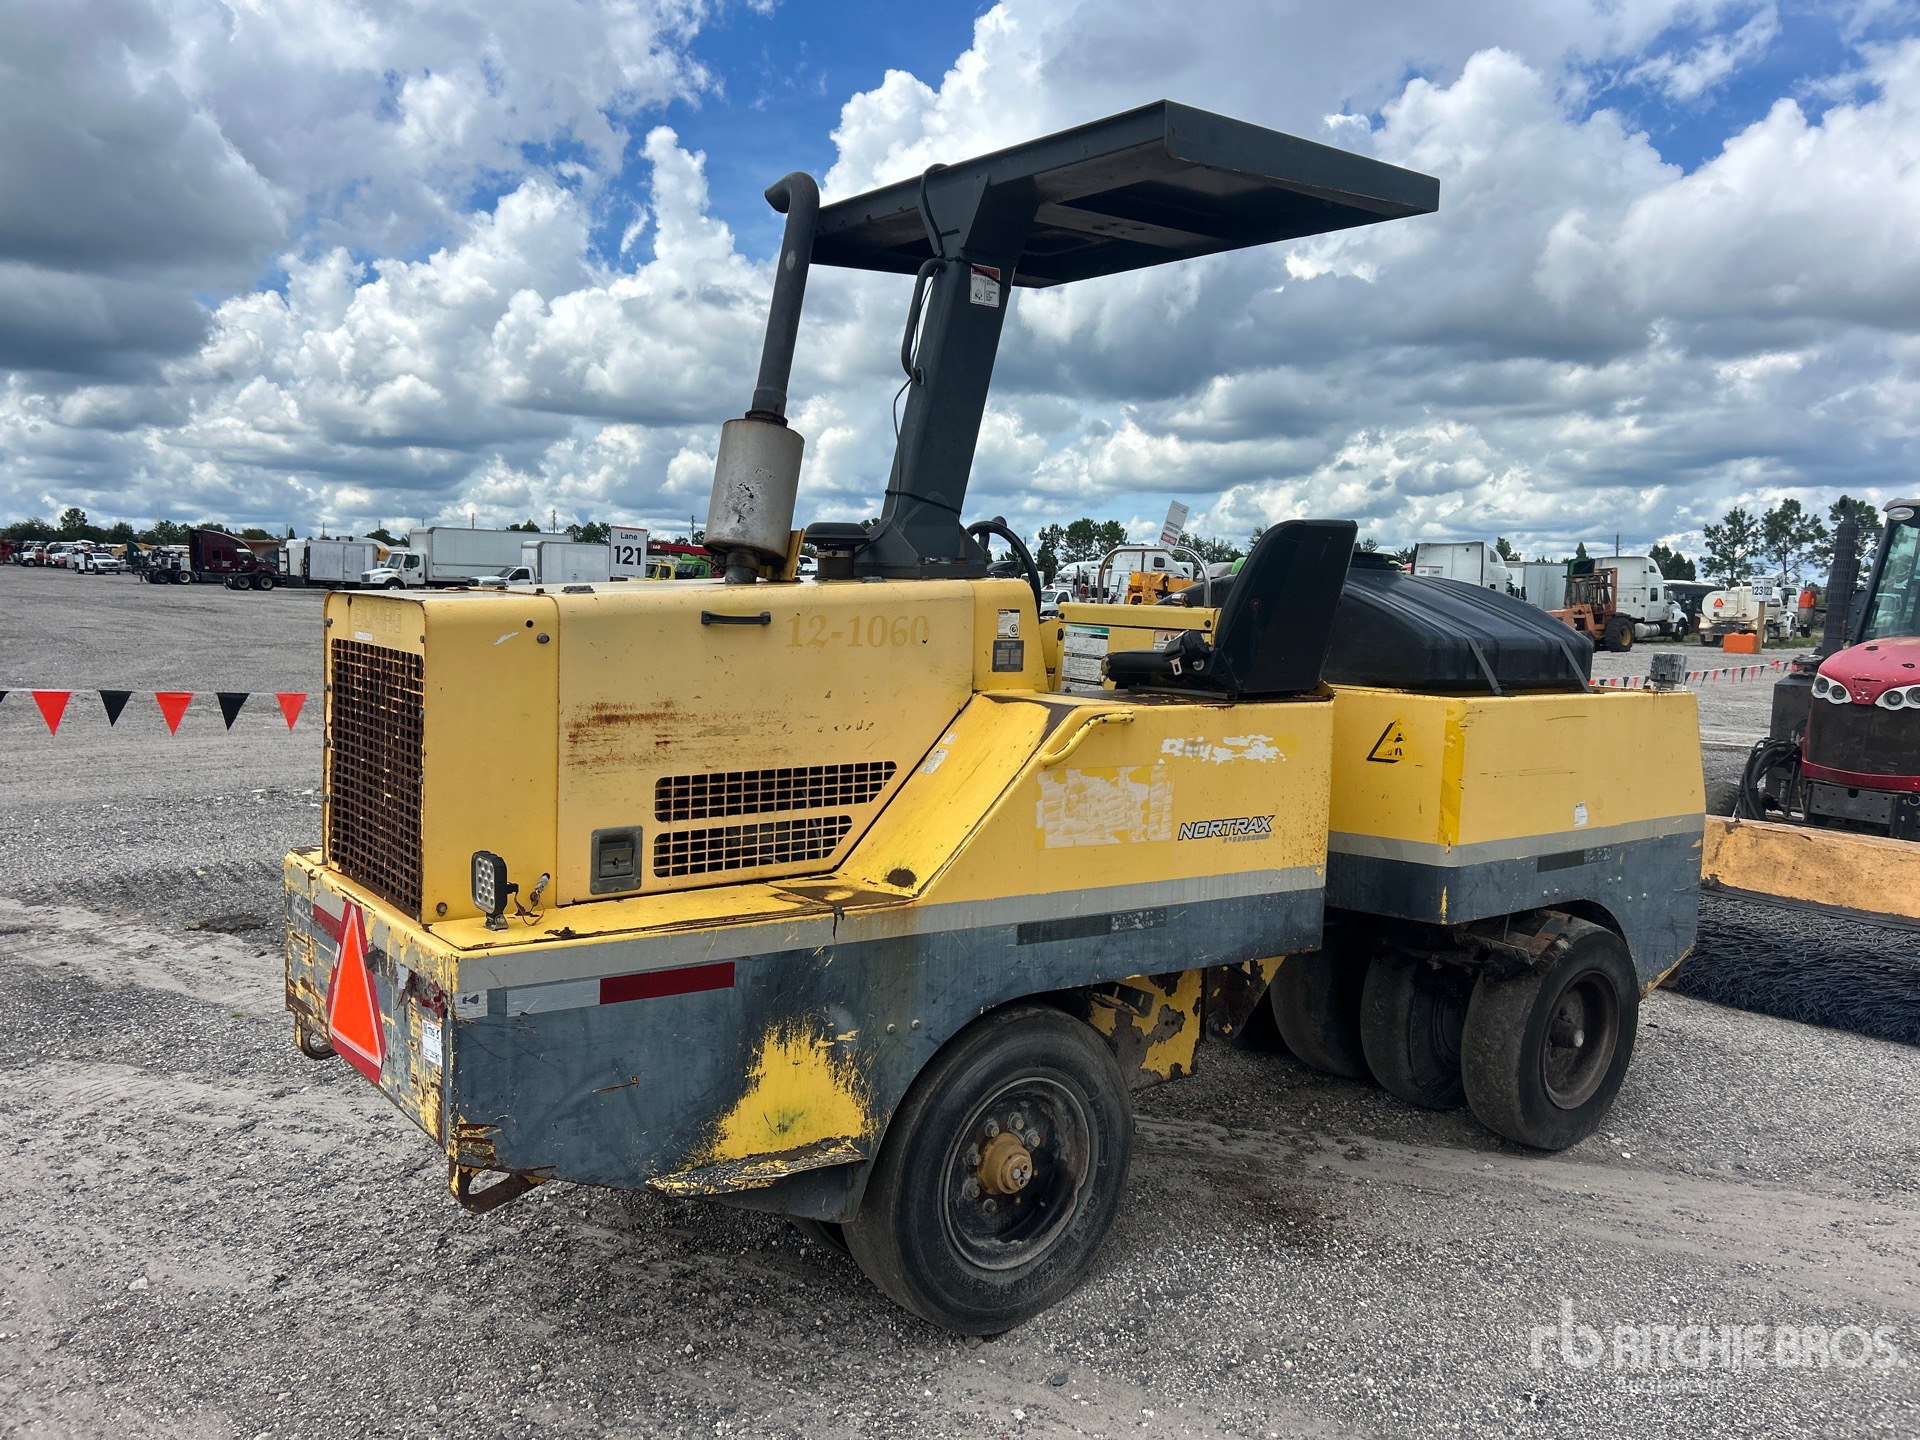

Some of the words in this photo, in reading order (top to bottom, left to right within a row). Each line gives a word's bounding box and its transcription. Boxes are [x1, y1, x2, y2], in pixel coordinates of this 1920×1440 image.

[620, 531, 638, 541] Lane
[614, 545, 642, 566] 121
[1752, 586, 1763, 596] 123
[786, 614, 930, 648] 12-1060
[1177, 814, 1276, 841] NORTRAX
